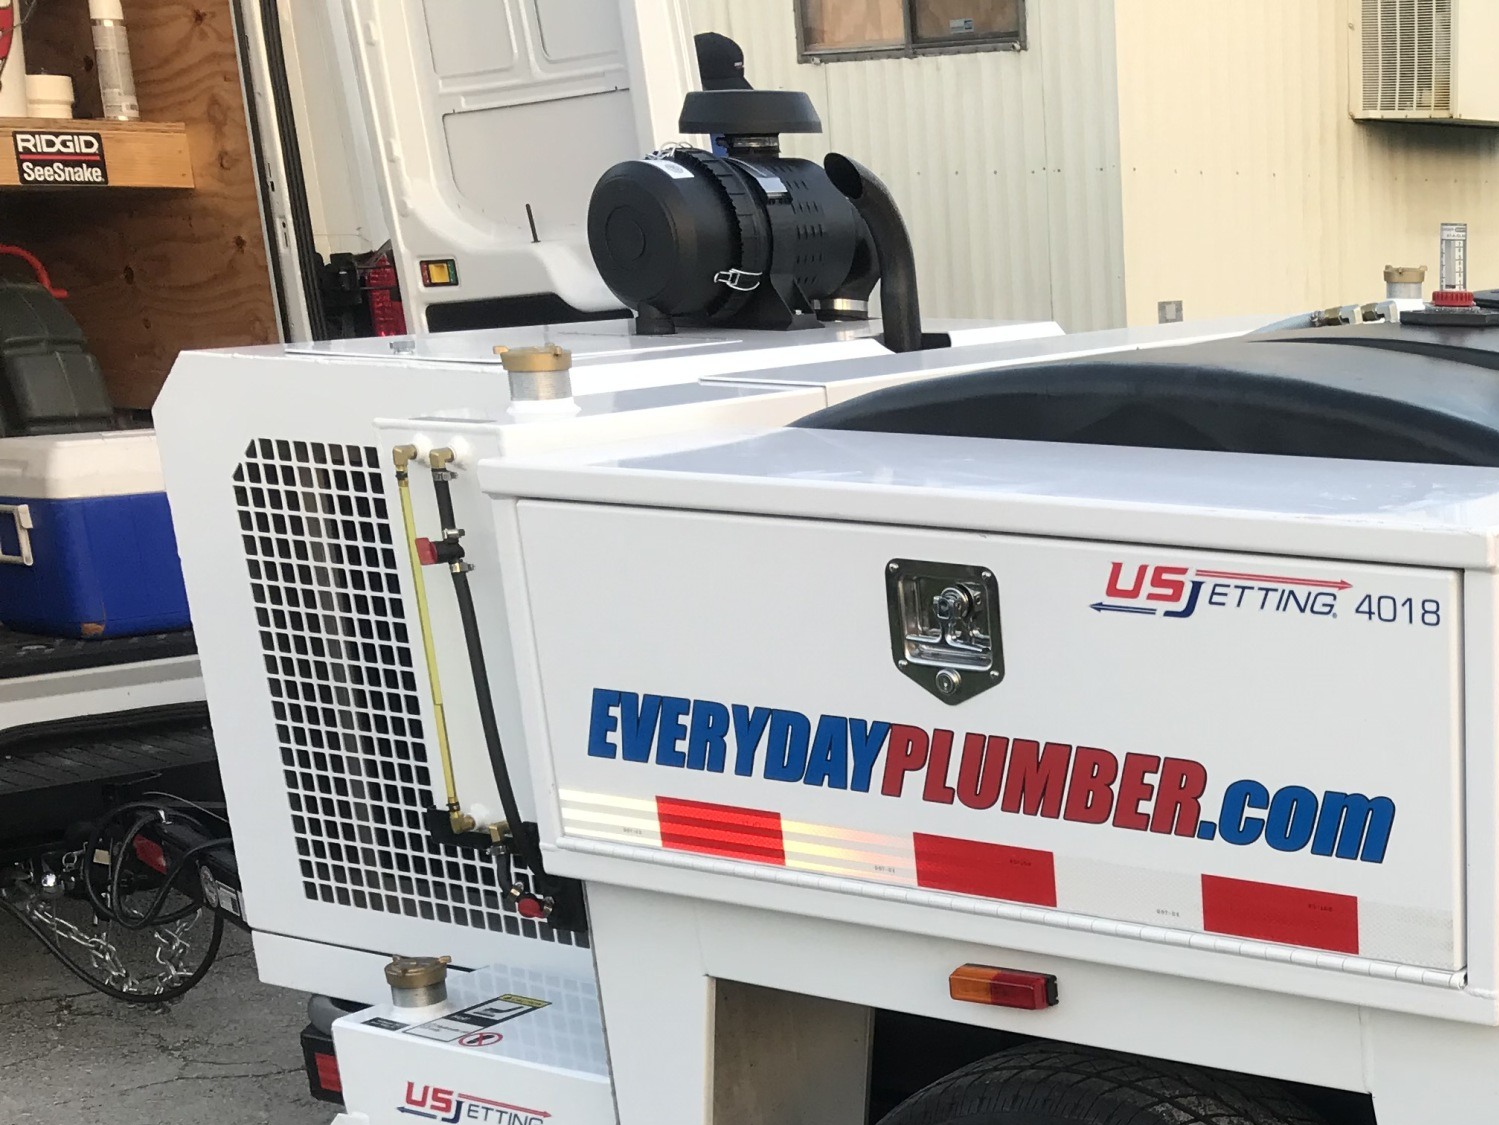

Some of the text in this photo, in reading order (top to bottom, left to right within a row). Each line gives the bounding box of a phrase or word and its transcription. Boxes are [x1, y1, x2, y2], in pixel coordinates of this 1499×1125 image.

[15, 133, 99, 153] RIDGID
[22, 162, 104, 182] SeeSnake
[1355, 594, 1441, 627] 4018
[587, 687, 1397, 864] EVERYDAYPLUMBER.com
